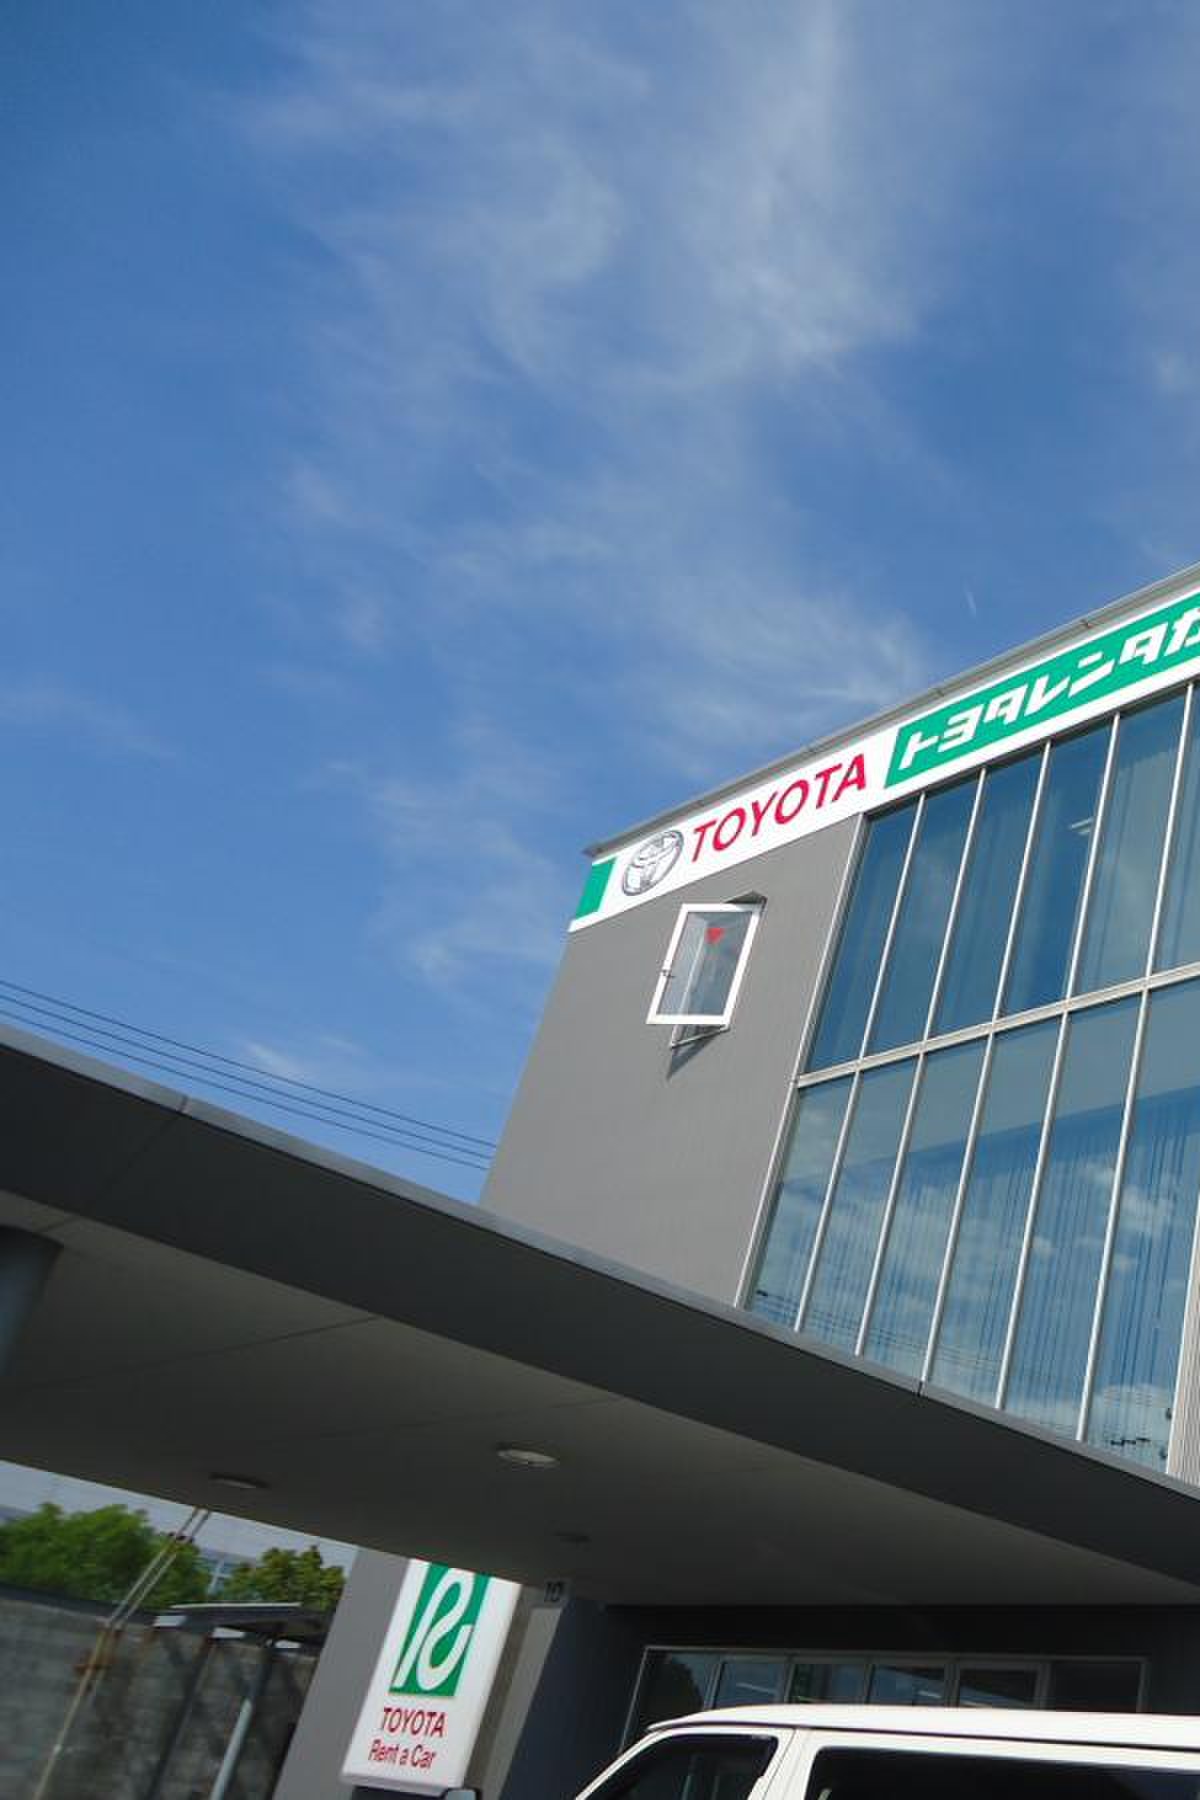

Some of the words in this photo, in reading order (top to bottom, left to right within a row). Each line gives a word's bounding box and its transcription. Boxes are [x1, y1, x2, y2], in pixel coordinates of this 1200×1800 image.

[692, 753, 868, 862] TOYOTA
[381, 1706, 447, 1738] TOYOTA
[368, 1739, 399, 1764] Rent
[399, 1748, 409, 1765] a
[411, 1744, 437, 1769] Car
